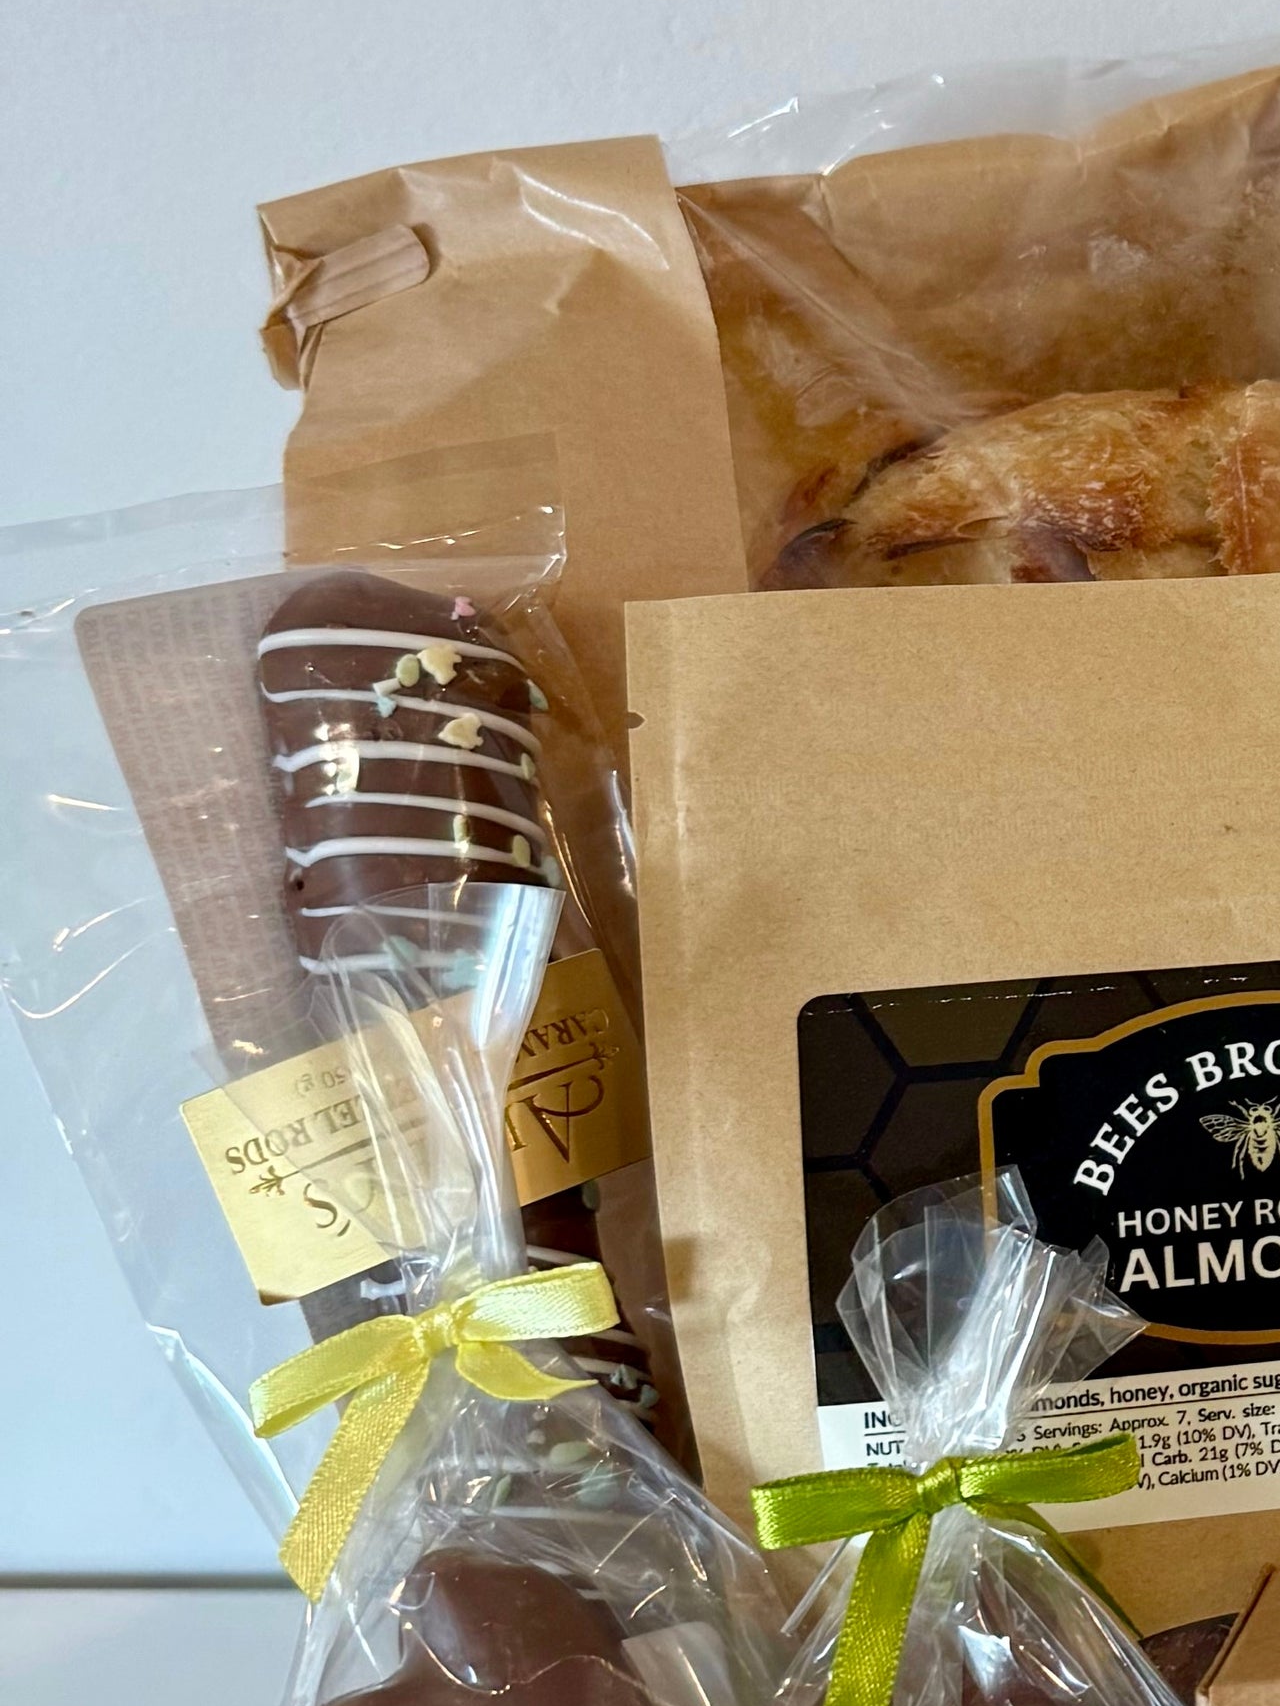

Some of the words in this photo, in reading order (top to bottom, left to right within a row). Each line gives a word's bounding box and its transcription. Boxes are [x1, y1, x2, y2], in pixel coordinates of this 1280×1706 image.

[223, 1117, 311, 1176] RODS
[1073, 1072, 1180, 1196] BEES
[1117, 1201, 1243, 1239] HONEY
[1028, 1387, 1105, 1413] monds,
[1109, 1381, 1174, 1406] honey,
[1177, 1373, 1248, 1399] organic
[1033, 1419, 1103, 1442] Servings:
[1175, 1409, 1191, 1426] 7,
[1197, 1406, 1235, 1423] Serv.
[1241, 1401, 1275, 1418] size:
[1176, 1427, 1217, 1446] (10%
[1221, 1422, 1255, 1441] DV),
[1151, 1448, 1192, 1466] Carb.
[1197, 1444, 1228, 1464] 21g
[1234, 1440, 1264, 1460] (7%
[1157, 1466, 1219, 1487] Calcium
[1221, 1460, 1251, 1482] (1%
